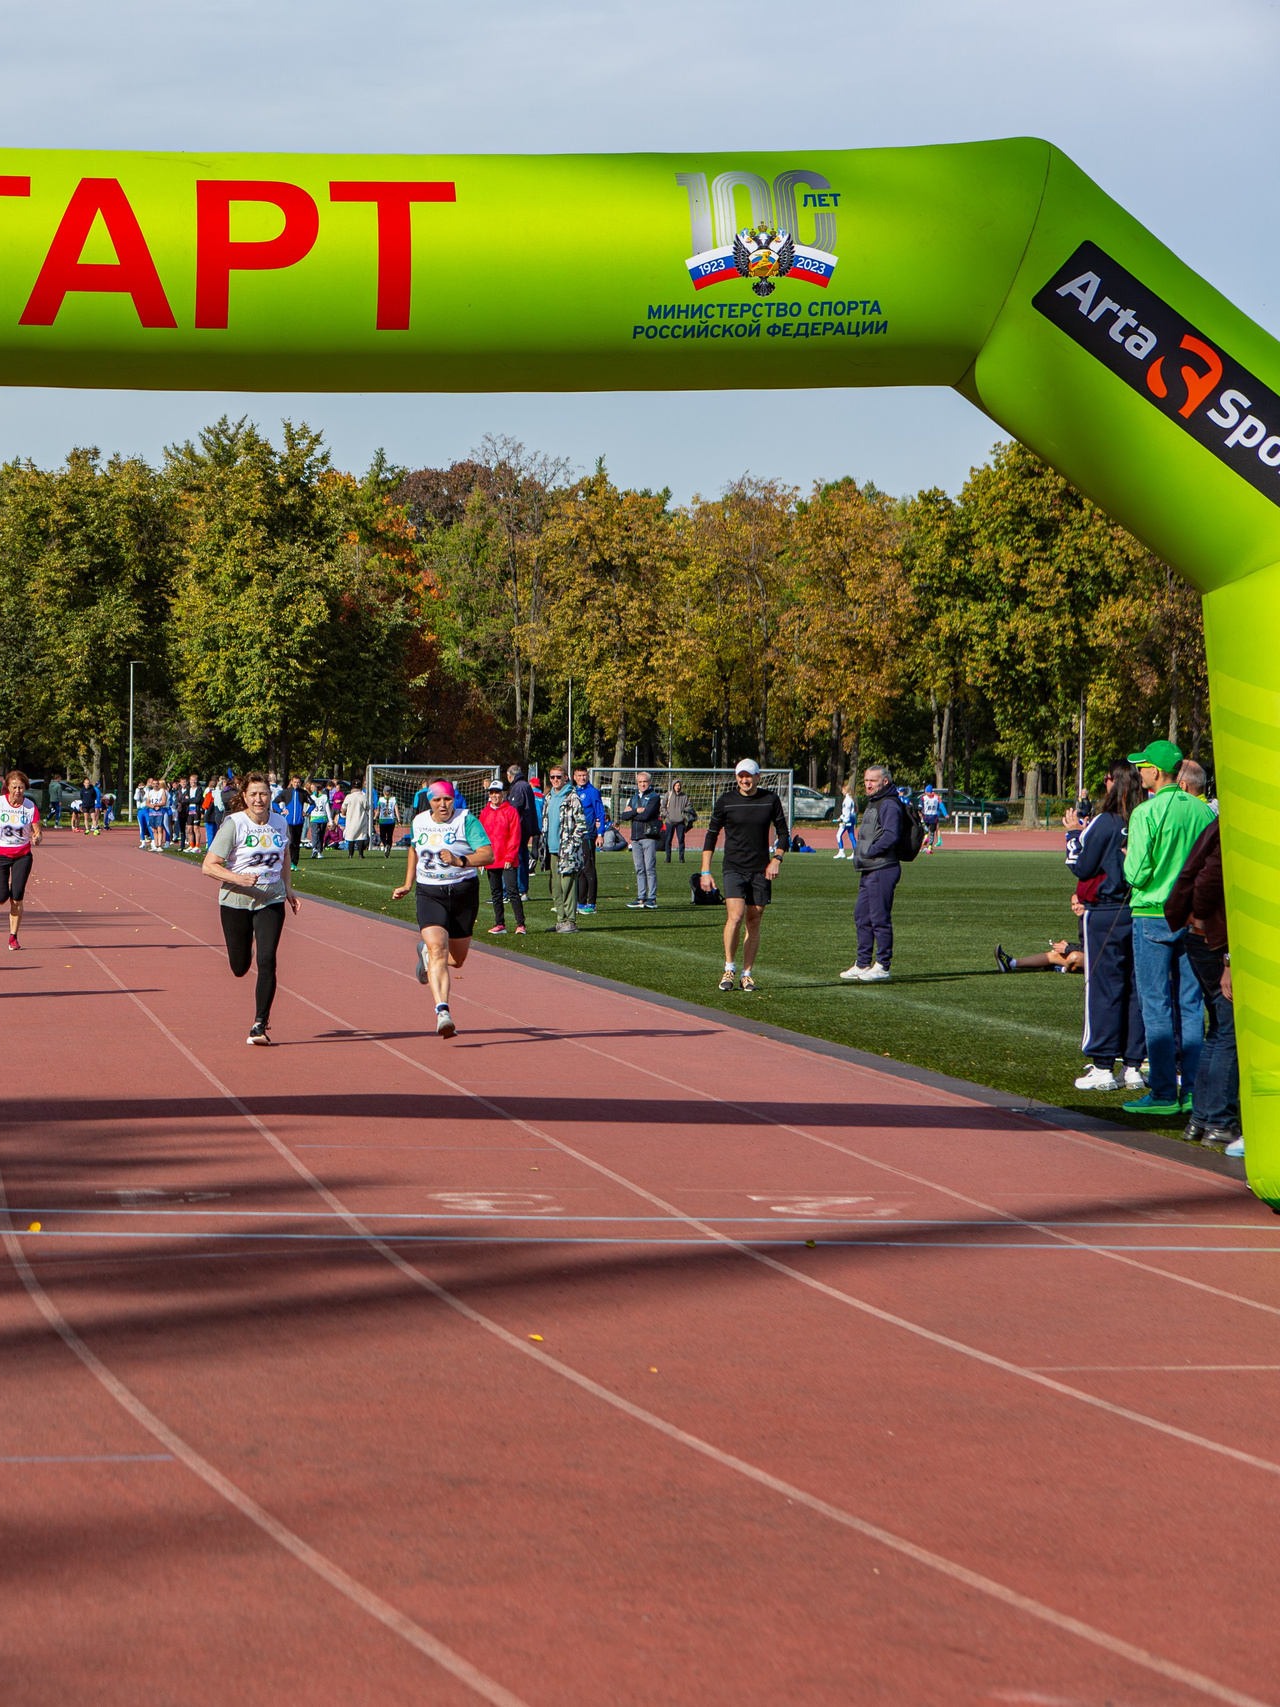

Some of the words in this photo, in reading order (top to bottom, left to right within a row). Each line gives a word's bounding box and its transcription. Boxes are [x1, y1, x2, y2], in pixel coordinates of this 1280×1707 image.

[802, 193, 841, 208] ЛЕТ
[698, 259, 726, 276] 1923
[796, 257, 826, 275] 2023
[647, 301, 802, 320] МИНИСТЕРСТВО
[807, 300, 882, 316] СПОРТА
[632, 320, 761, 340] РОССИЙСКОЙ
[766, 320, 888, 339] ФЕДЕРАЦИИ
[1055, 270, 1158, 360] Arta
[1206, 388, 1280, 474] Spo
[3, 825, 24, 837] 31
